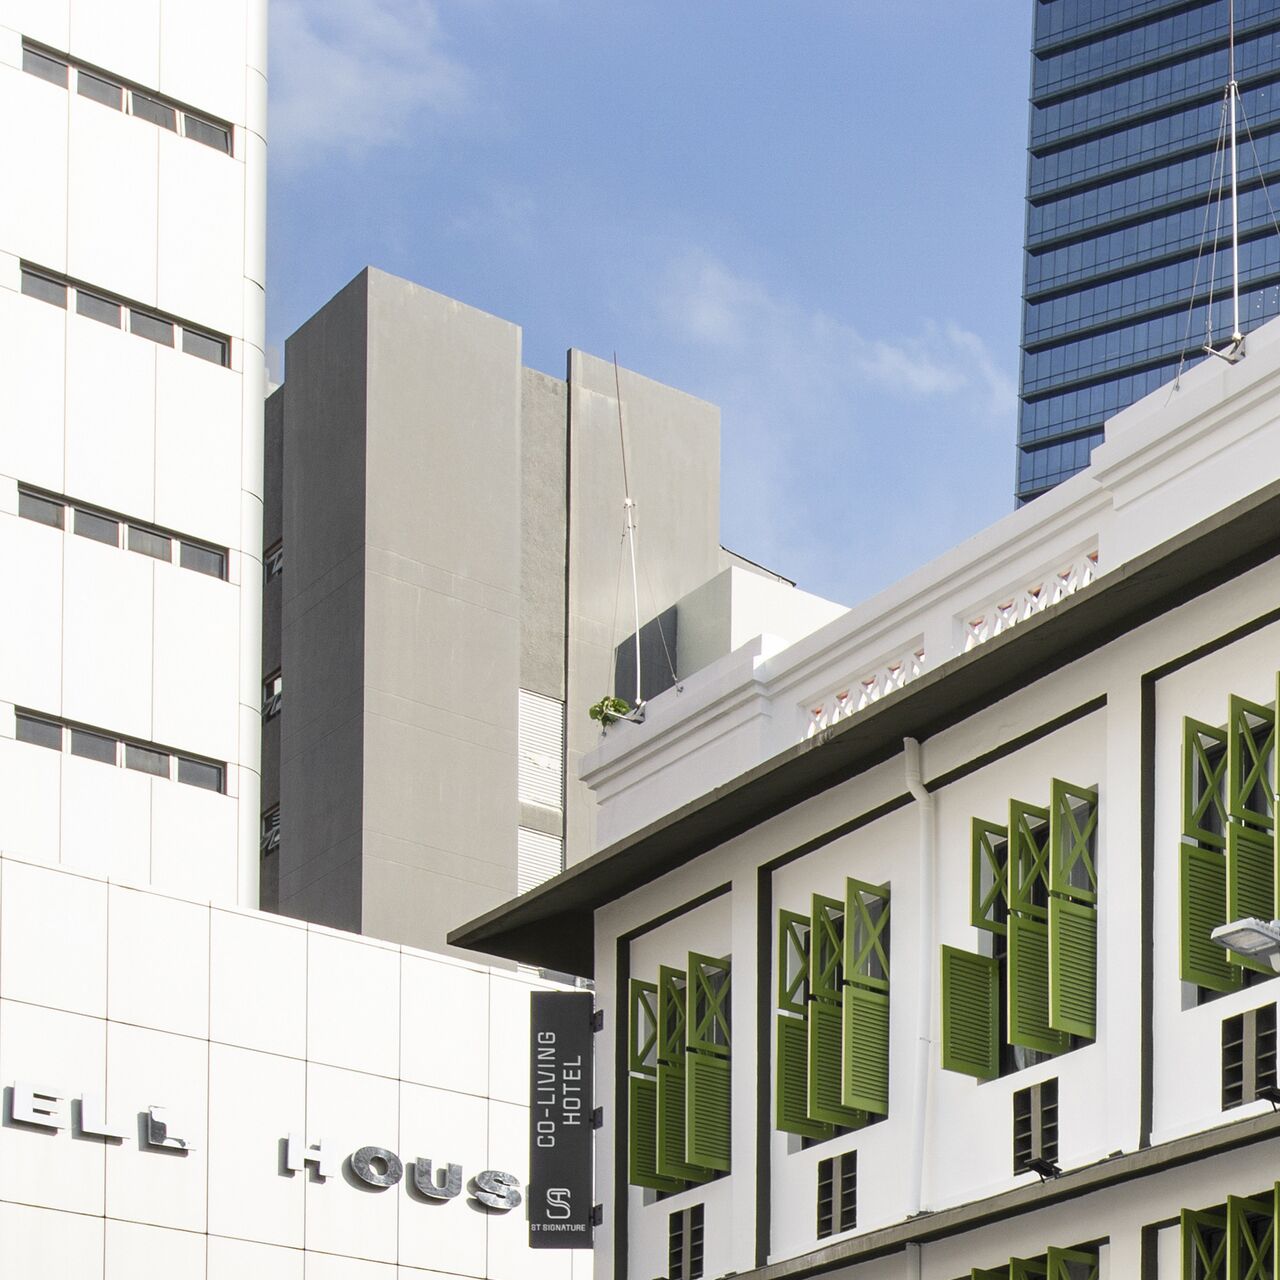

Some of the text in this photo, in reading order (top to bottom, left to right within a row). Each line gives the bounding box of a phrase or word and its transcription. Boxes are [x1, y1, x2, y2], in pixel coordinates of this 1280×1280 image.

[537, 1032, 556, 1148] CO-LIVING
[562, 1055, 581, 1125] HOTEL
[284, 1131, 524, 1211] HOUS
[531, 1223, 586, 1231] ST SIGNATURE
